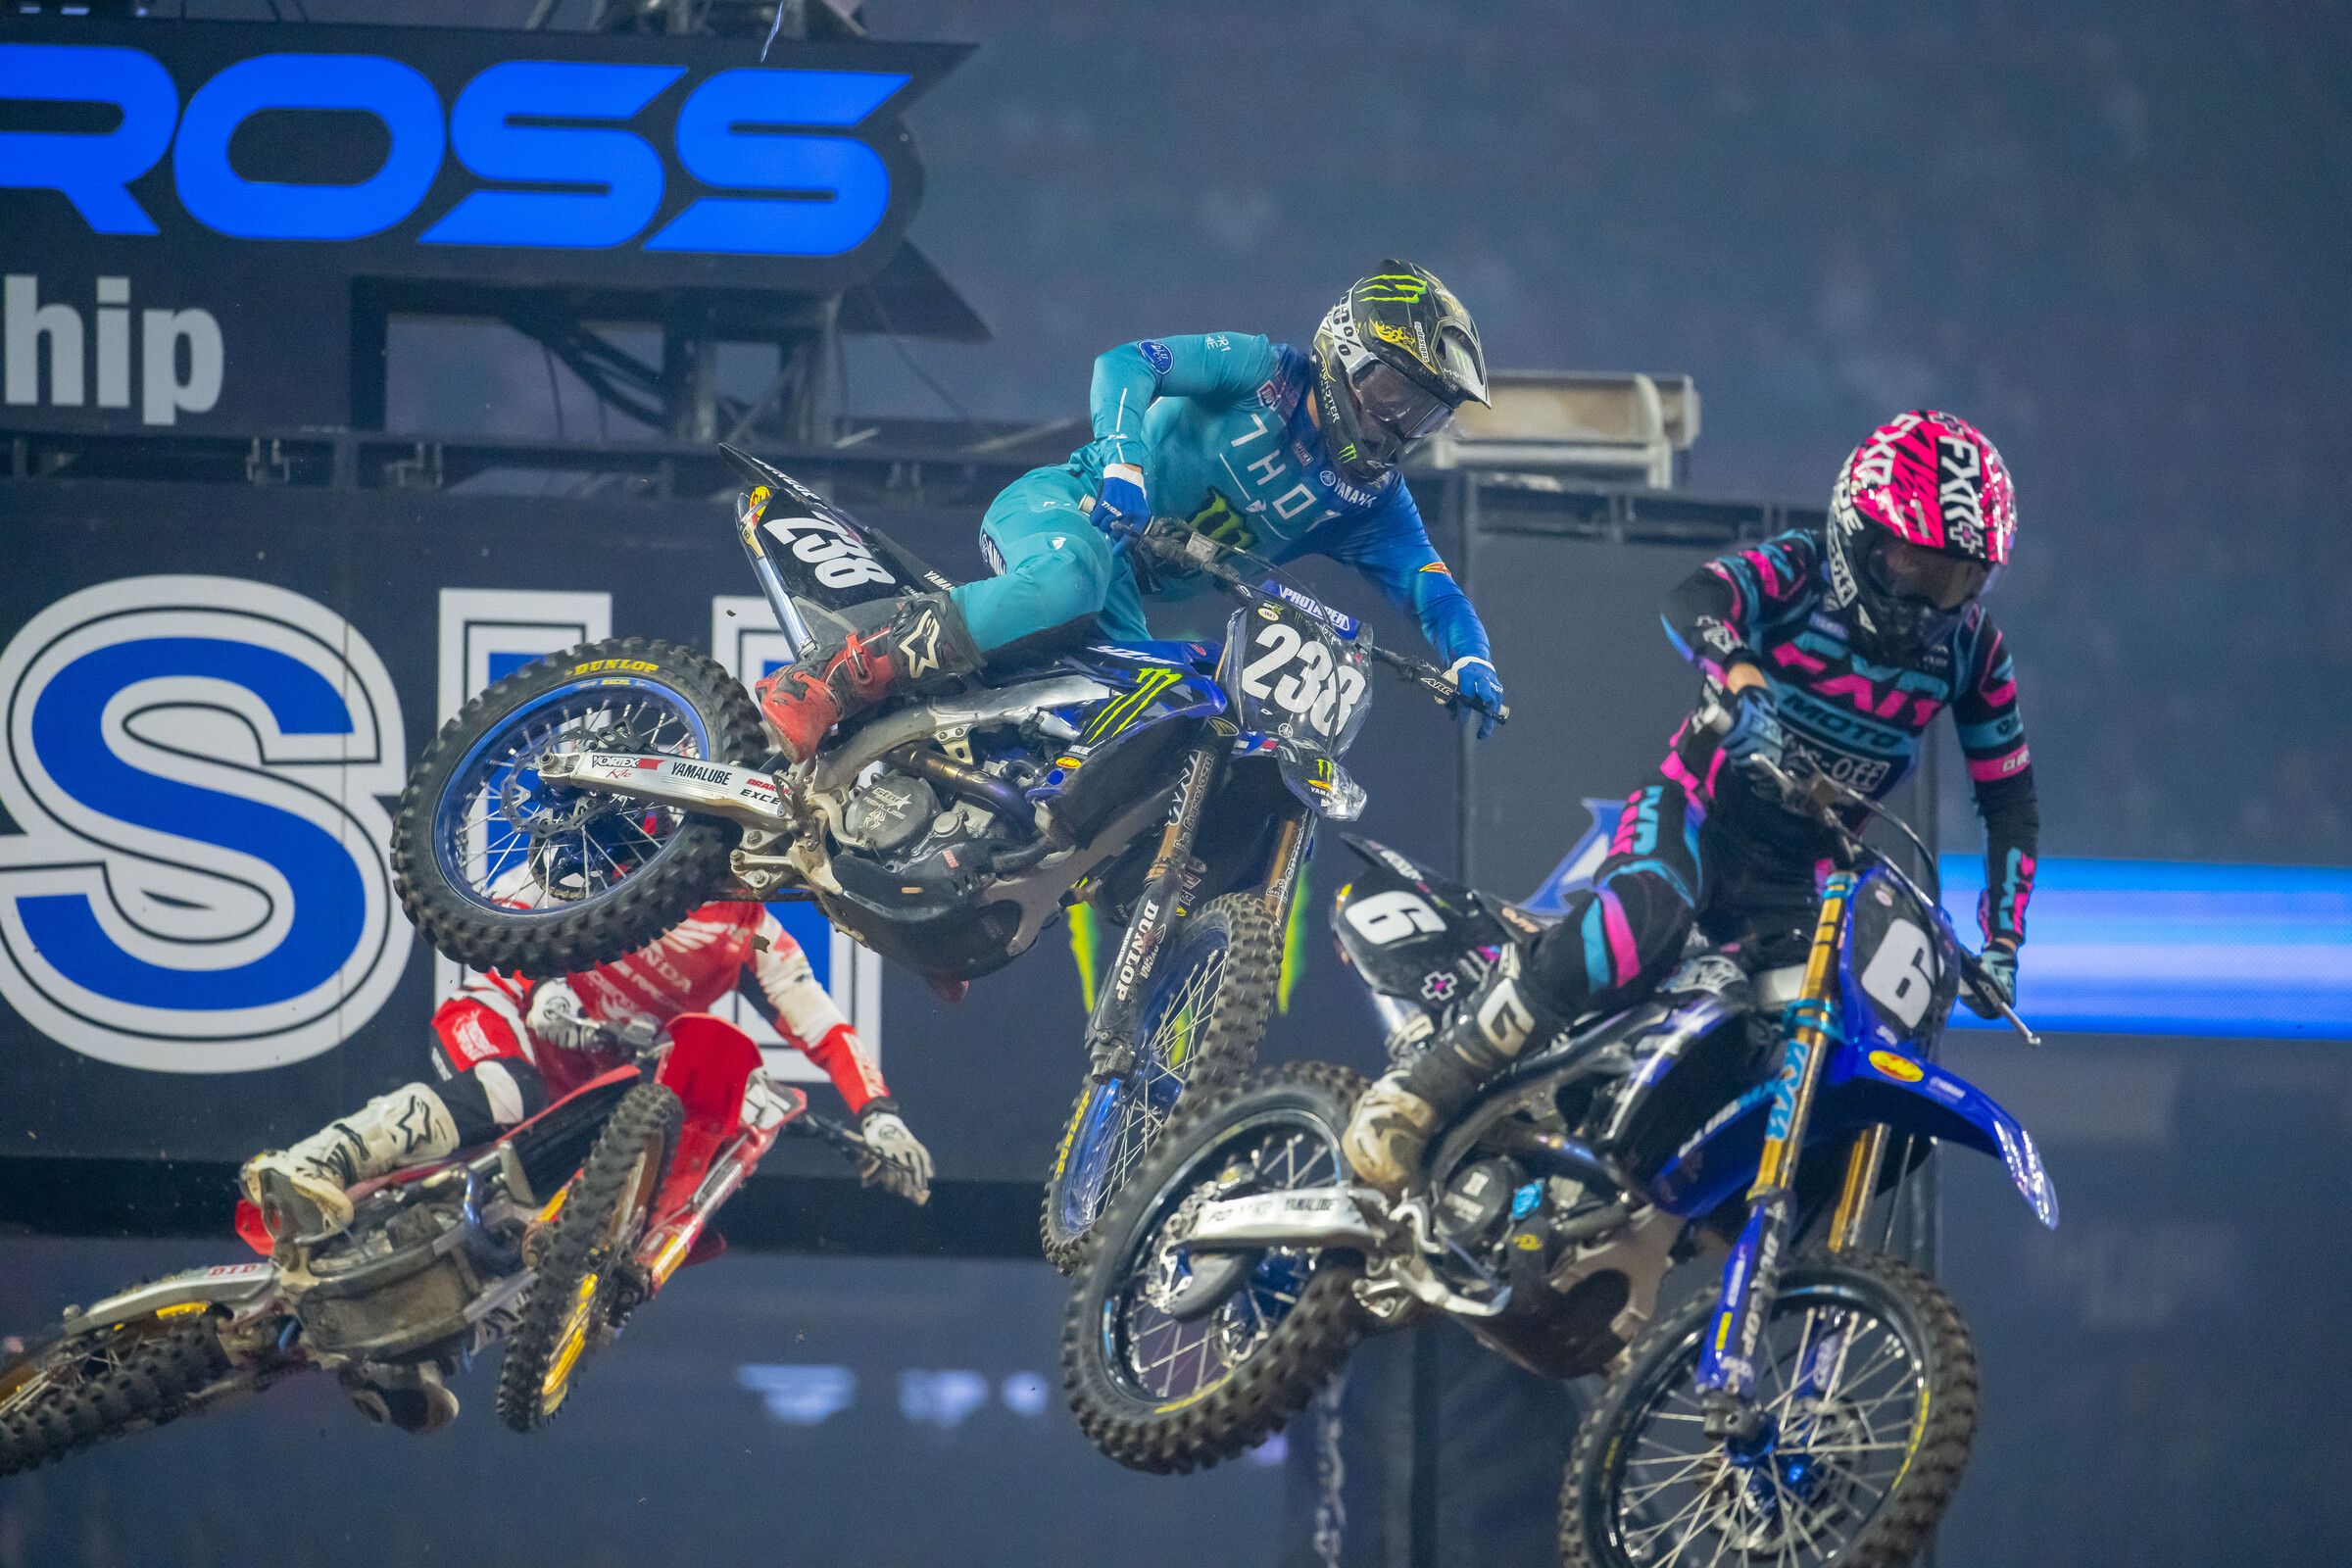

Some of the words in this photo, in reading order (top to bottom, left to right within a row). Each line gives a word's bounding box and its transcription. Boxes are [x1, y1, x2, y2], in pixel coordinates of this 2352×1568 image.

[0, 43, 912, 257] ROSS
[4, 274, 224, 425] hip
[1101, 500, 1123, 517] THOR
[762, 511, 897, 589] 238
[573, 659, 660, 676] DUNLOP
[1242, 623, 1366, 737] 238
[592, 755, 641, 769] VORTEX
[671, 761, 733, 787] YAMALUBE
[1115, 899, 1160, 1002] DUNLOP
[1346, 891, 1447, 945] 6
[1861, 928, 1936, 1029] 6
